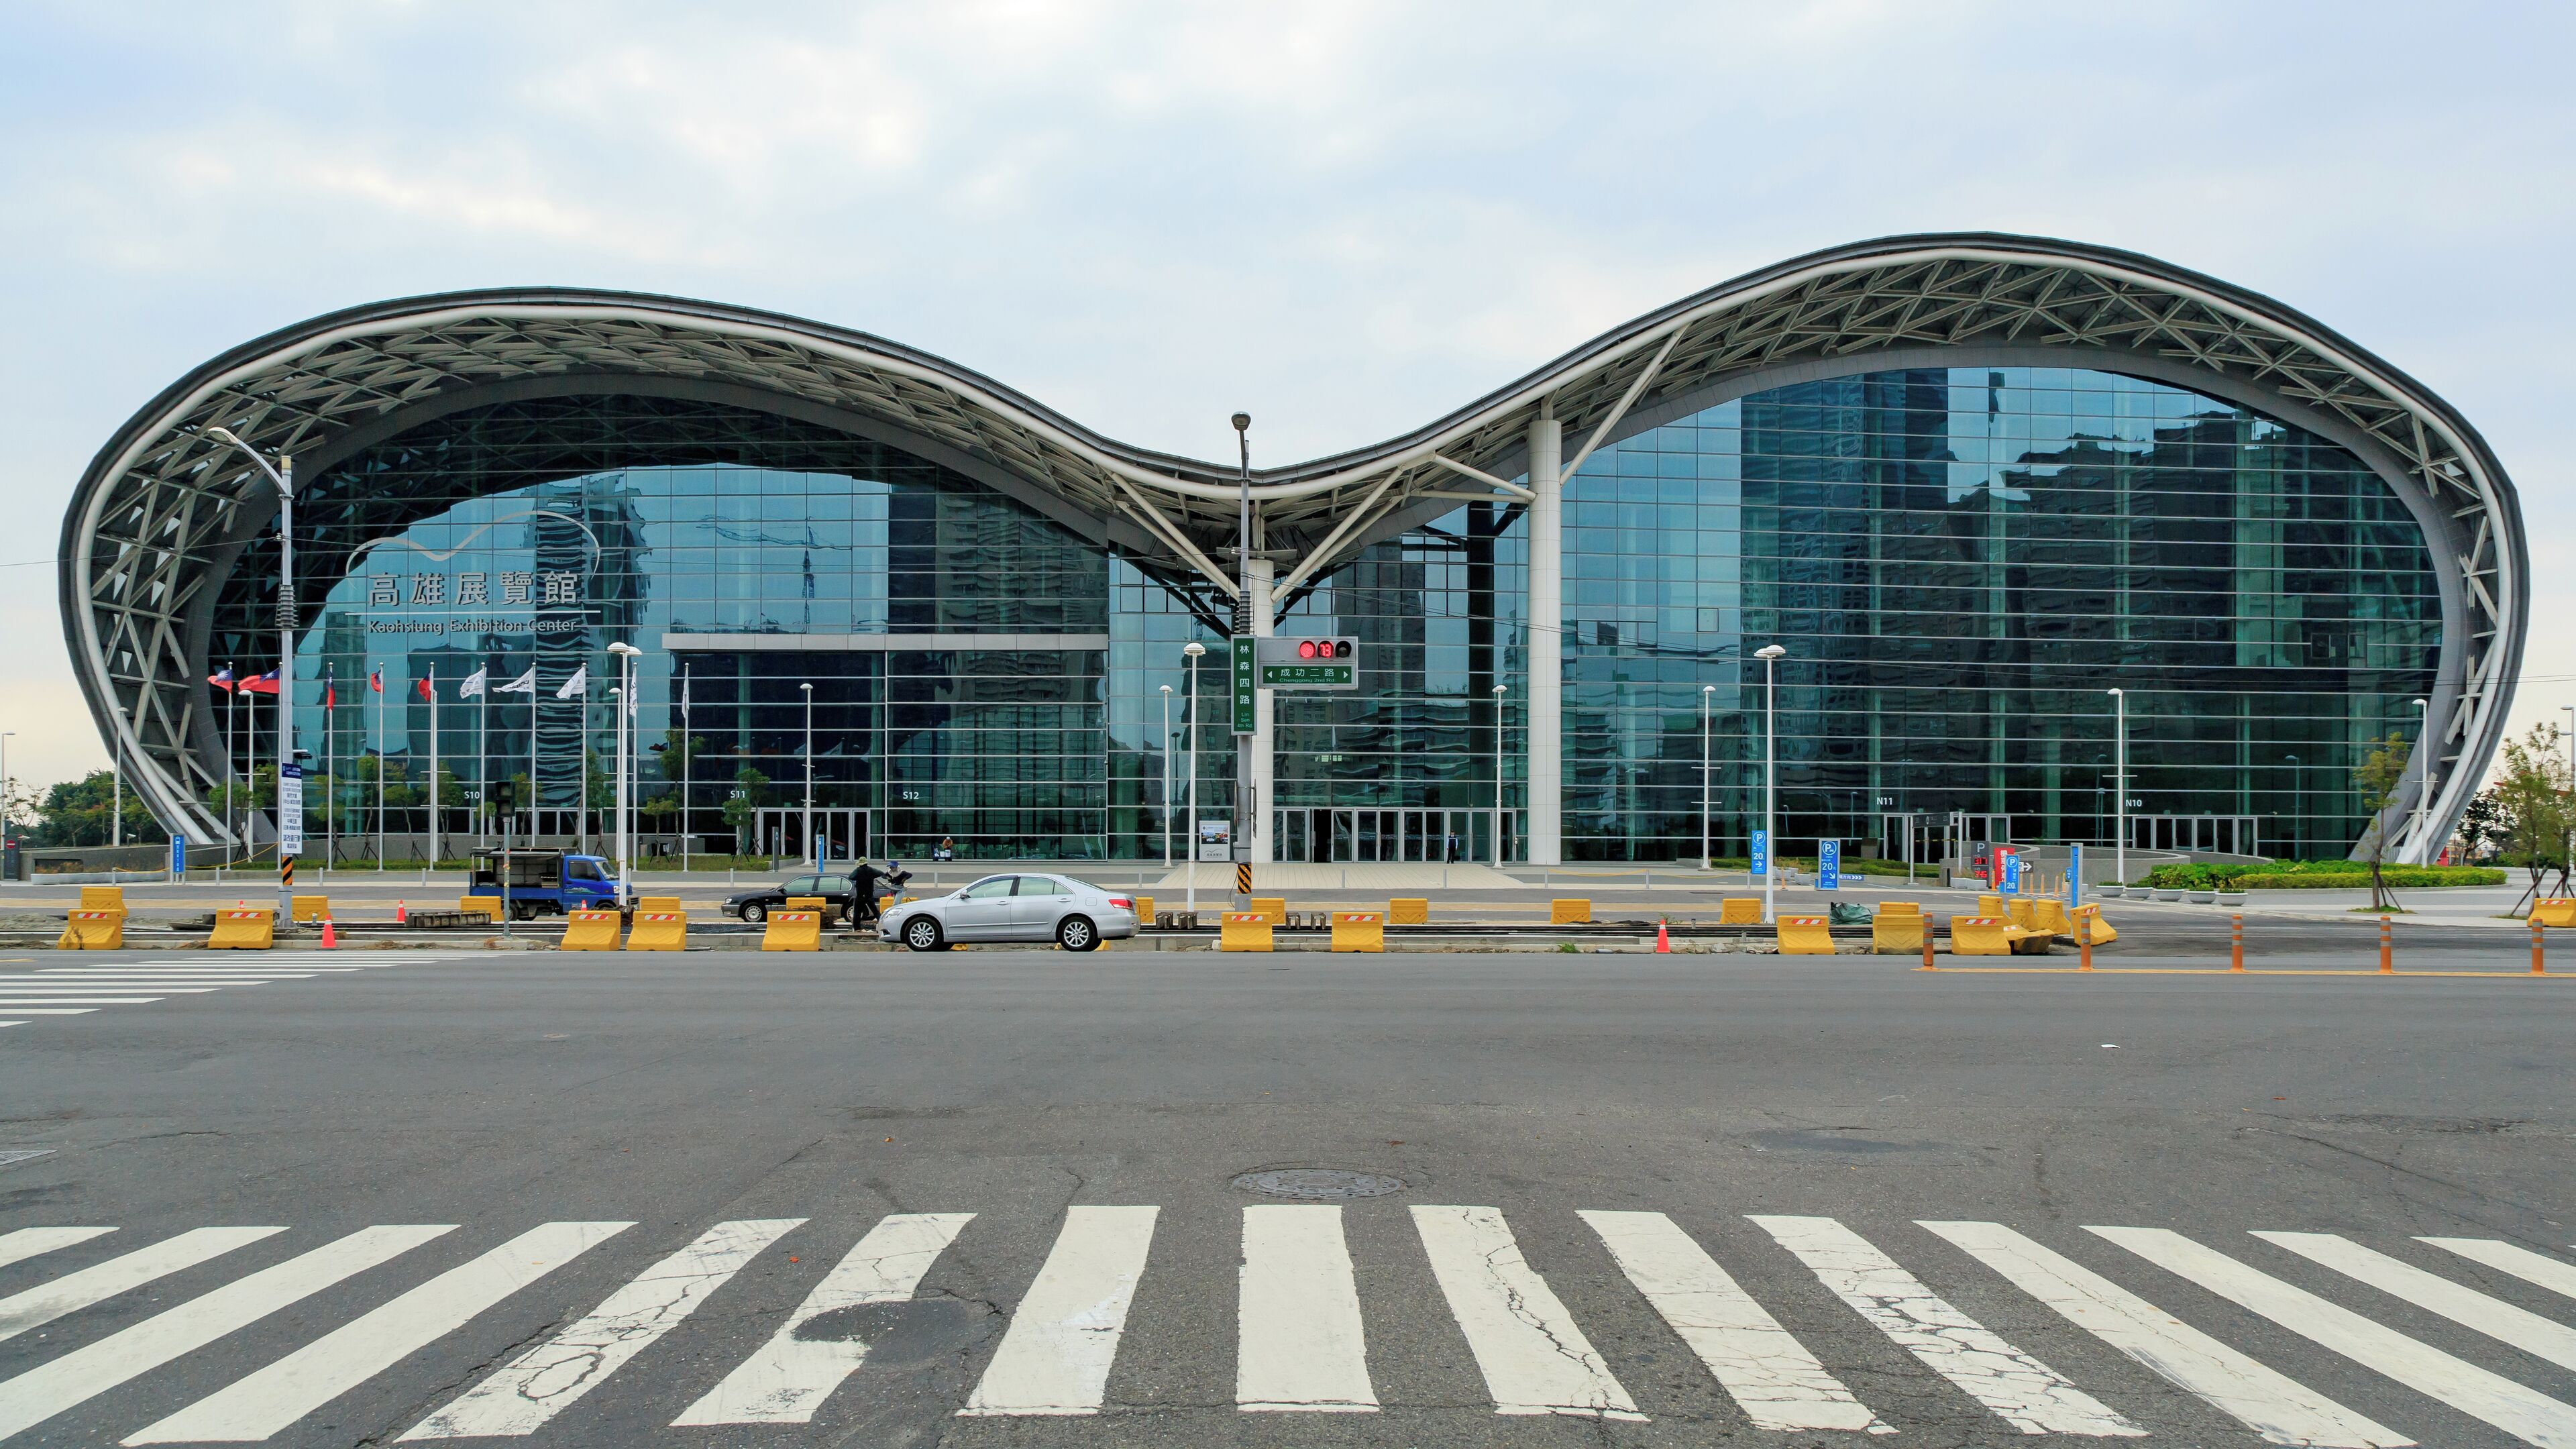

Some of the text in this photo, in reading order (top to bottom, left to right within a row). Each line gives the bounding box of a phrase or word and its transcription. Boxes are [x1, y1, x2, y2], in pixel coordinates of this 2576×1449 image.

[369, 571, 578, 604] 高雄展覽館
[370, 619, 576, 635] Kaohsiung Exhibition Center
[1239, 645, 1249, 704] 林森四路
[1281, 669, 1334, 677] 成功二路
[464, 791, 480, 799] S10
[730, 790, 745, 798] S11
[903, 791, 919, 799] S12
[1876, 797, 1892, 805] N11
[2125, 799, 2142, 807] N10
[1756, 833, 1763, 842] P
[1825, 843, 1831, 852] P
[1977, 843, 1985, 853] P
[1753, 852, 1764, 860] 20
